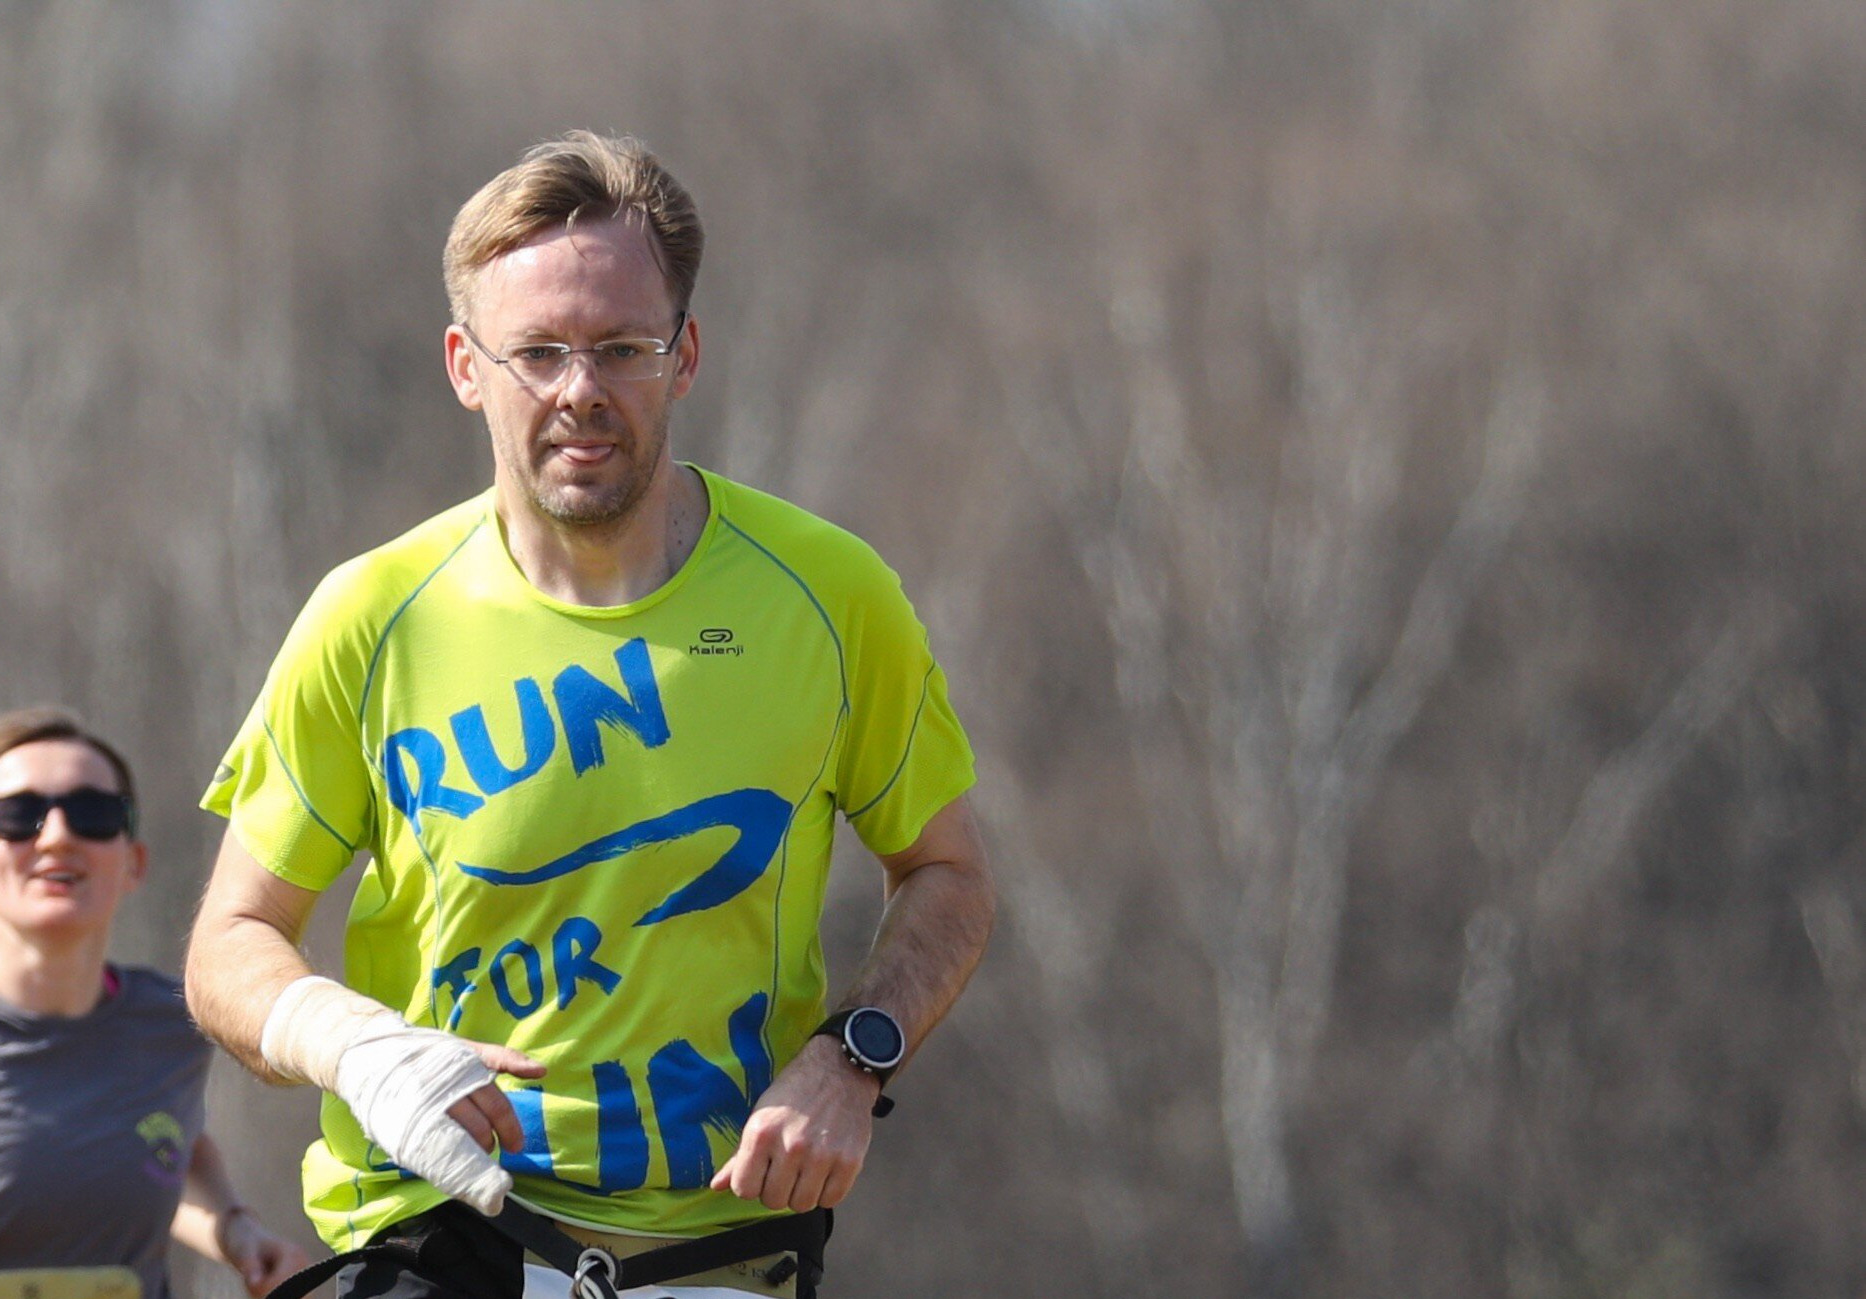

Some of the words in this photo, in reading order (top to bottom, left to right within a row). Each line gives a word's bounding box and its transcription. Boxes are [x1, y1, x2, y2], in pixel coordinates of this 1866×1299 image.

[384, 637, 671, 835] RUN
[689, 645, 744, 657] Kalenji
[398, 990, 773, 1196] UN
